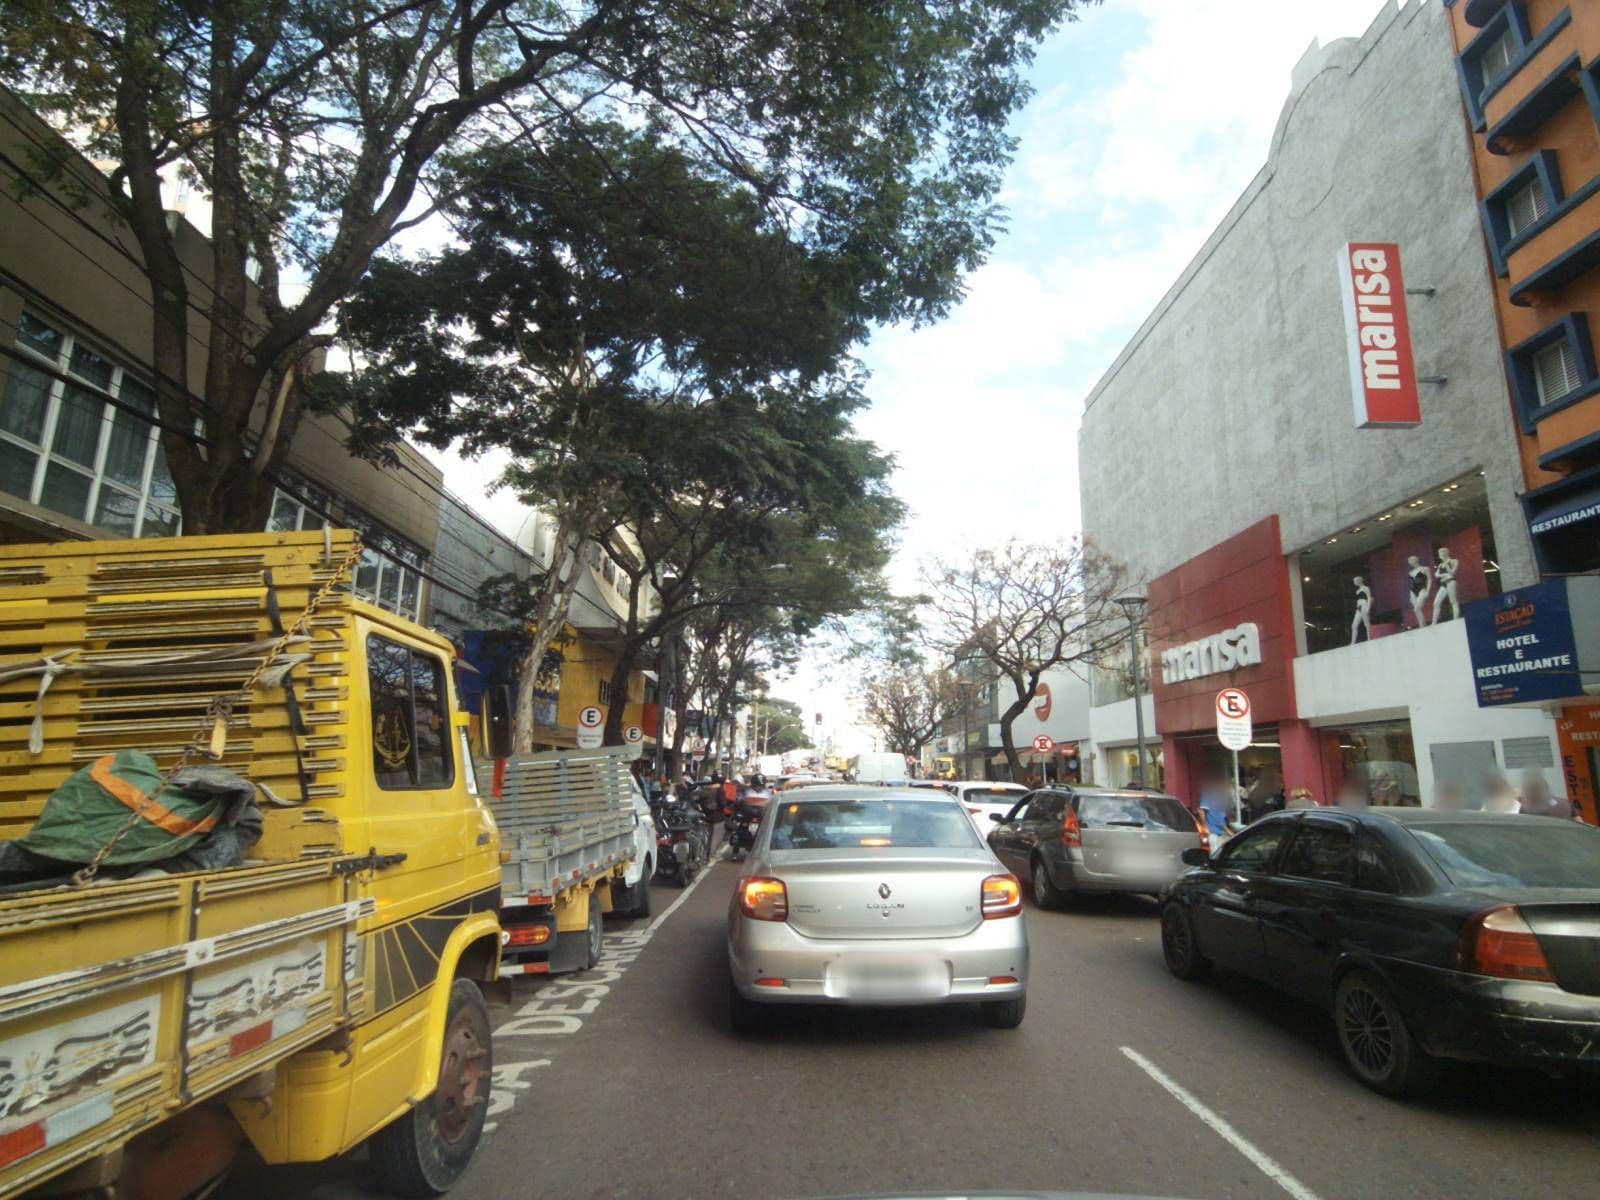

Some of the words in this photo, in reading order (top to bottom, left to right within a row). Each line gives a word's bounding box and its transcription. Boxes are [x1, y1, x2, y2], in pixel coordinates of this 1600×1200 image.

[1352, 250, 1401, 389] marisa
[1496, 634, 1539, 650] HOTEL
[1161, 622, 1261, 685] marisa
[1515, 650, 1524, 659] E
[1477, 655, 1570, 678] RESTAURANTE
[586, 710, 596, 723] E
[629, 728, 637, 739] E
